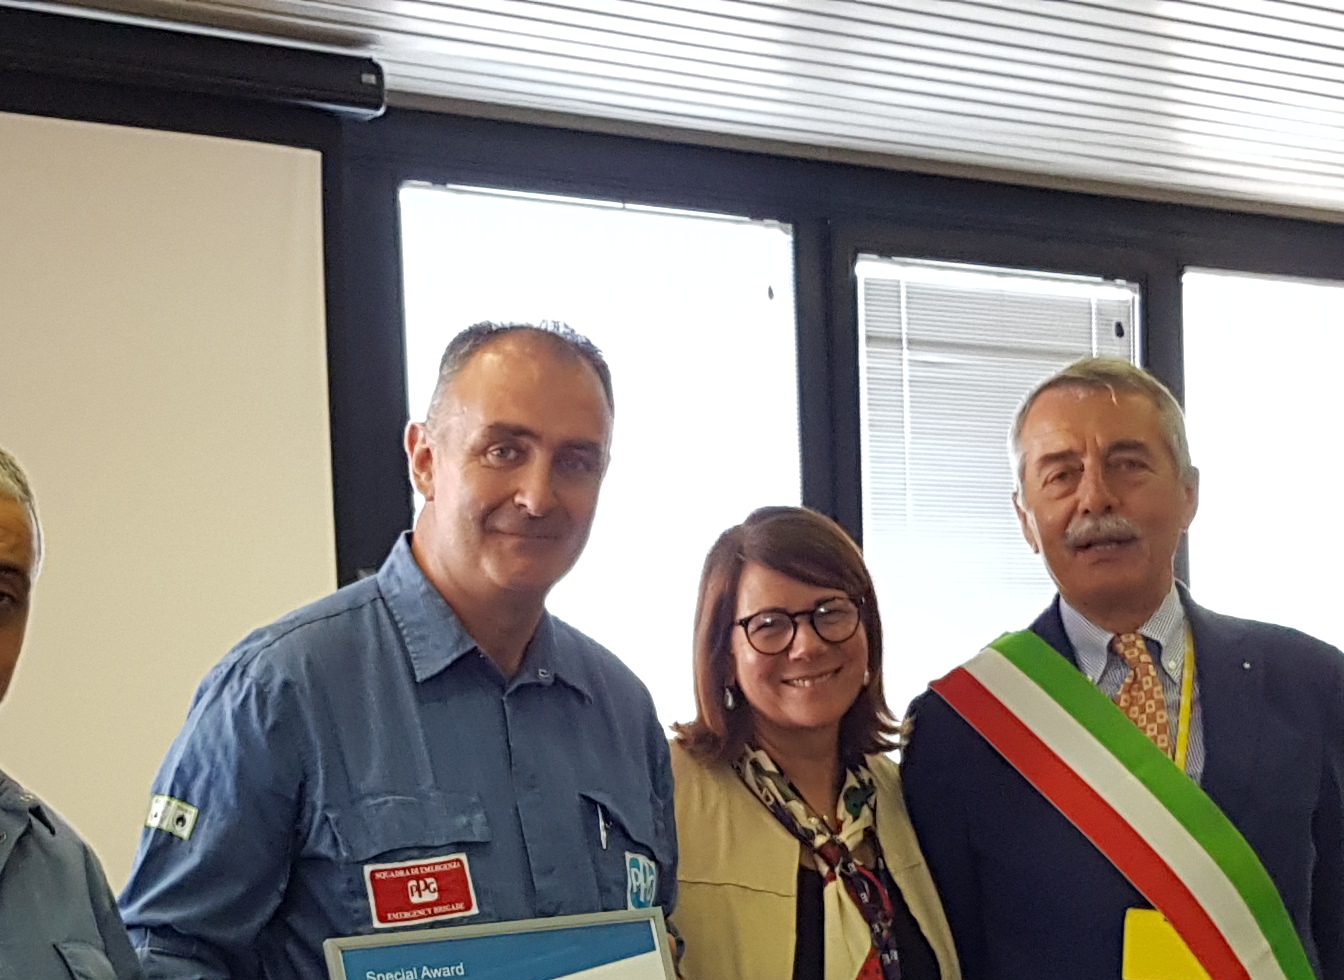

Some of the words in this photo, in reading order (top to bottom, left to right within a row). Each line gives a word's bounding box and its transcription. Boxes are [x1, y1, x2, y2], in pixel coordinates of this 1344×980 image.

[409, 877, 437, 898] PPG
[386, 907, 433, 920] EMERGENCY
[421, 961, 465, 979] Award
